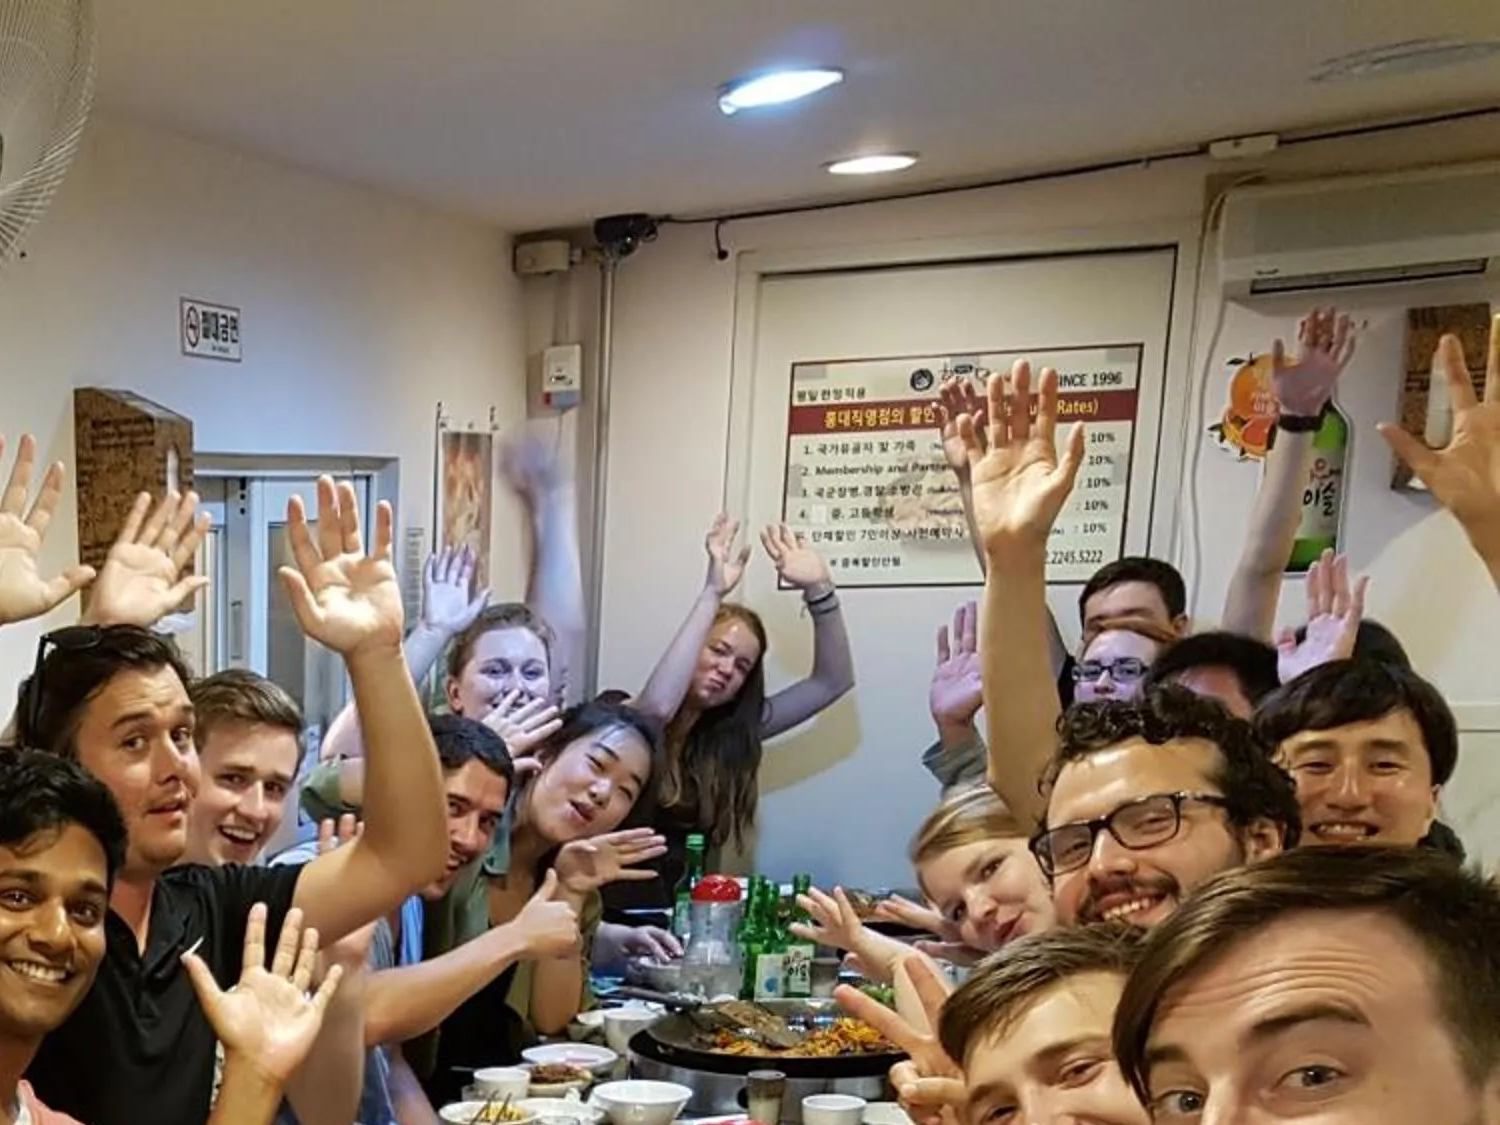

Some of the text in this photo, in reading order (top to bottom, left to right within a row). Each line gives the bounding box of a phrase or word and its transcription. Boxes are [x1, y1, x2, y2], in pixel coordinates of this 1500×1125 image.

[1057, 372, 1122, 388] INCE 1996
[1091, 432, 1116, 444] 10%
[1088, 455, 1114, 467] 10%
[1086, 477, 1112, 489] 10%
[1083, 500, 1109, 511] 10%
[1082, 522, 1108, 535] 10%
